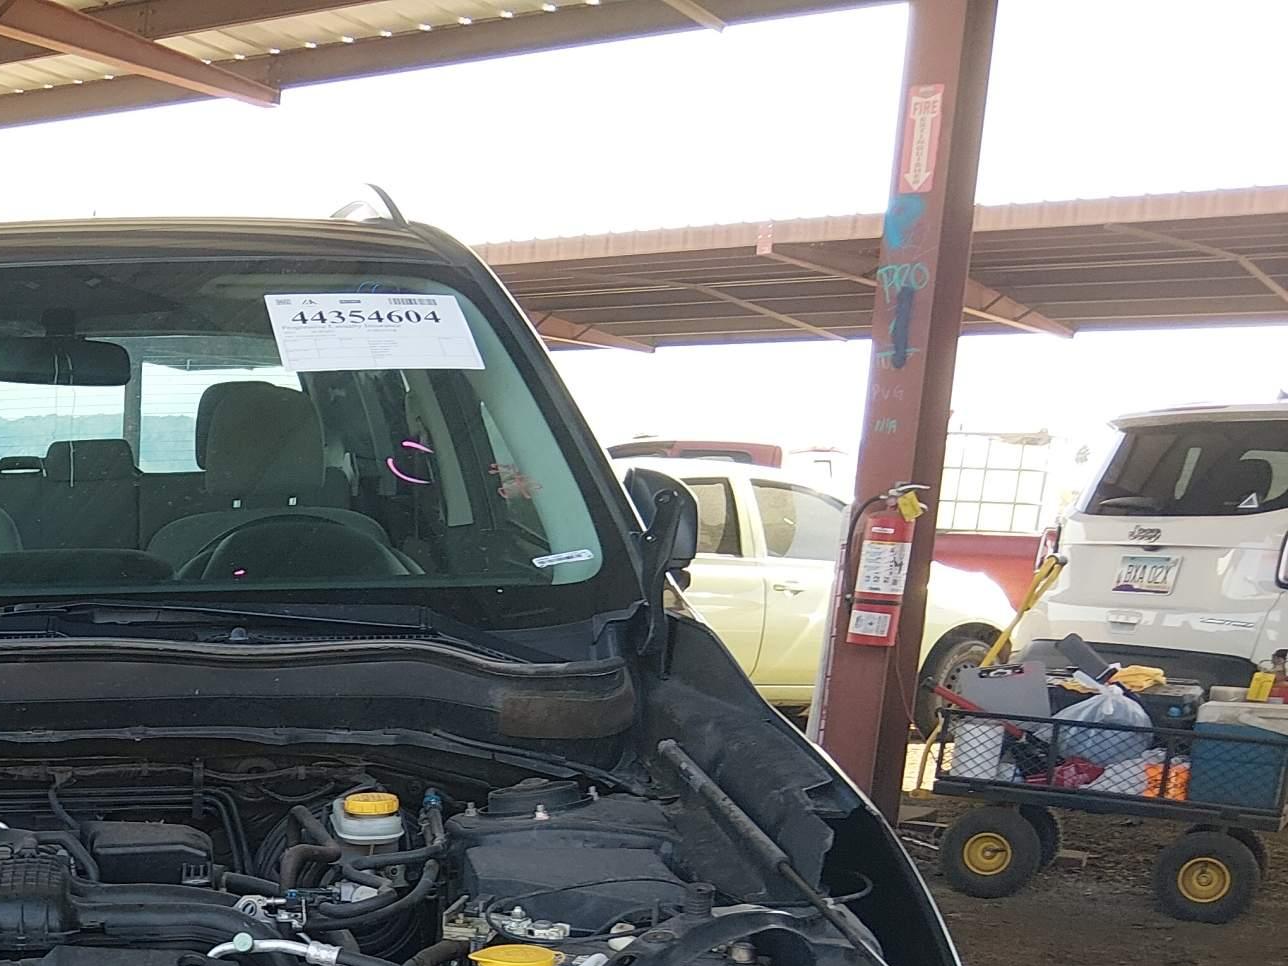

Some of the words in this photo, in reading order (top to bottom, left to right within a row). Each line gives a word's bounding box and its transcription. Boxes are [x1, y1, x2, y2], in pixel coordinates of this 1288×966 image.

[913, 99, 939, 117] FIRE
[291, 309, 442, 325] 44354604
[1127, 524, 1162, 544] Jeep
